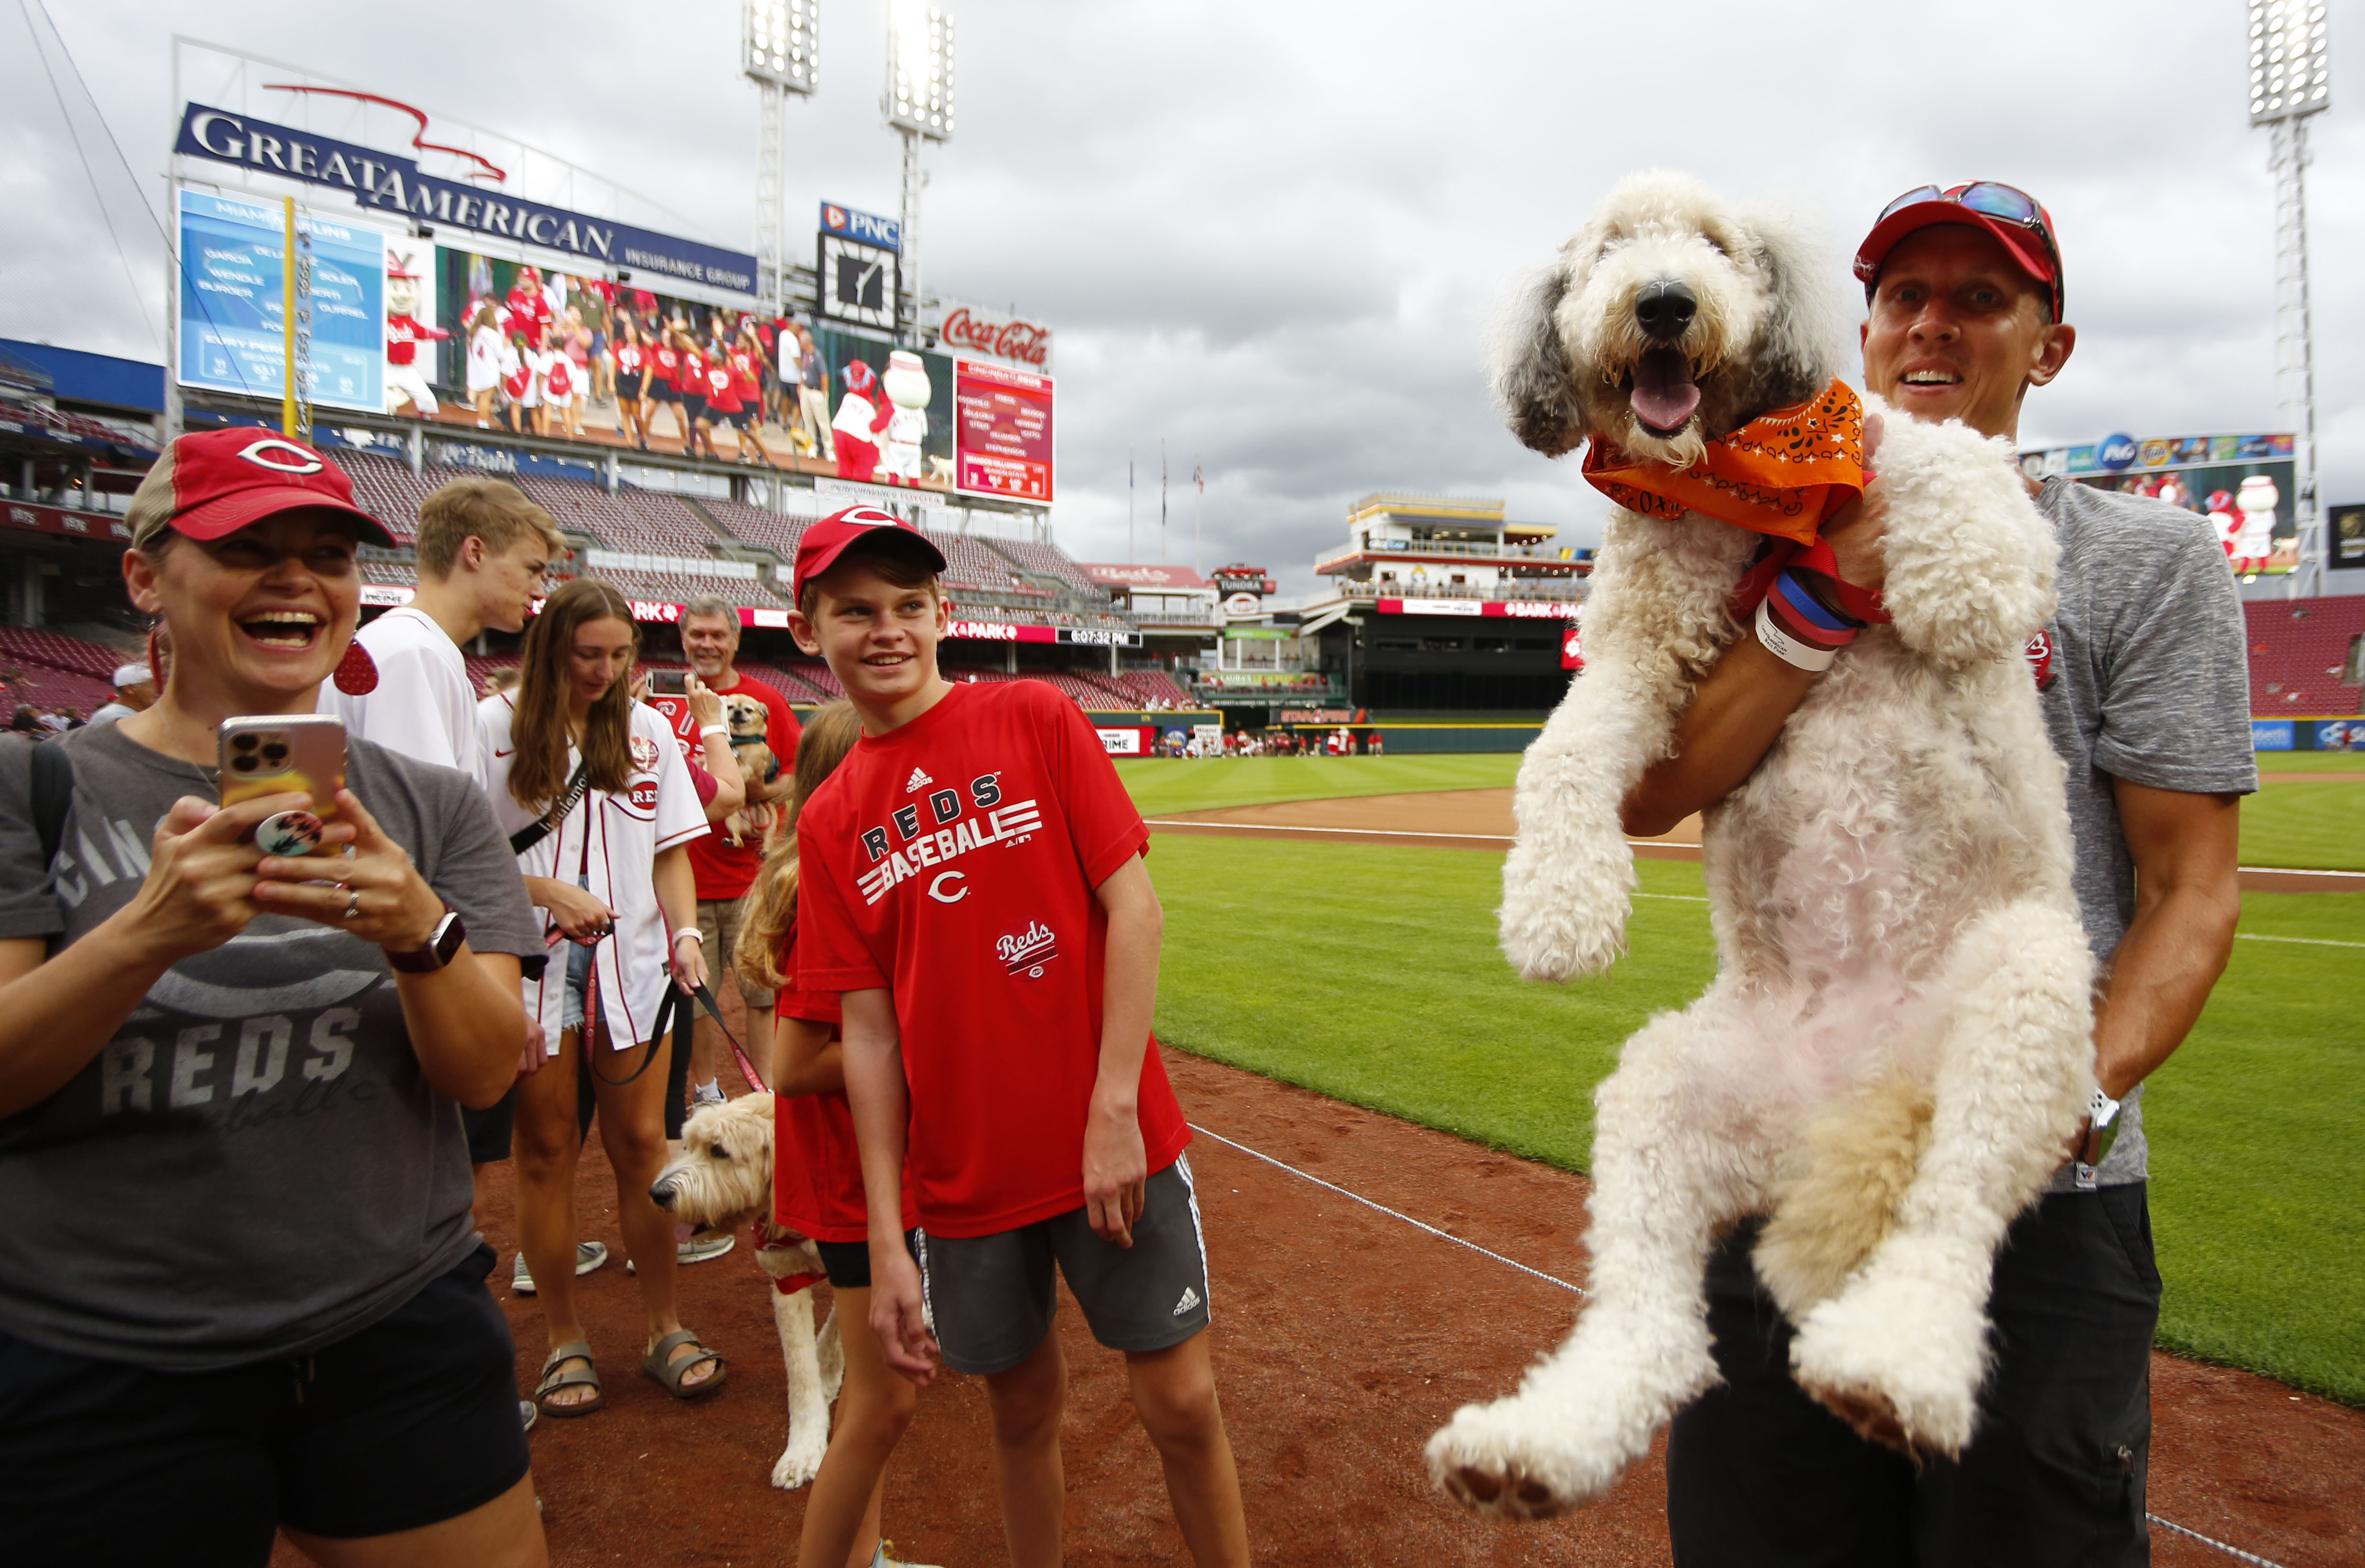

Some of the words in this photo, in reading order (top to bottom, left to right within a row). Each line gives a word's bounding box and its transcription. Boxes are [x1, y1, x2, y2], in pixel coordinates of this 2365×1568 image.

[192, 111, 386, 193] GREAT
[371, 169, 615, 257] AMERICAN
[272, 210, 352, 241] MRLINS
[850, 211, 897, 245] PNC
[204, 247, 253, 266] GARCIA
[208, 268, 264, 286] WENDLE
[318, 269, 358, 286] SOLER
[625, 247, 704, 281] INSURANCE
[706, 266, 750, 291] GROUP
[198, 279, 253, 299] BURGER
[317, 301, 368, 320] GURRIEL
[943, 307, 1051, 365] Coca-Cola
[241, 351, 286, 366] SEASO
[968, 363, 1016, 382] CINCINNATI
[990, 430, 1023, 443] WILLIAMSON
[2102, 443, 2136, 462] P&G
[992, 459, 1026, 472] WILLIAMSON
[830, 484, 896, 499] PERFORMANCE
[899, 492, 941, 504] TOYOTA
[1221, 581, 1260, 590] TUNDRA
[1516, 602, 1553, 618] BARK
[968, 622, 1007, 640] PARK
[1071, 629, 1111, 645] 6:07:32
[1112, 632, 1129, 646] PM
[1104, 739, 1128, 750] RIME
[906, 776, 933, 793] adidas
[631, 789, 657, 804] RE
[861, 774, 1001, 862] REDS
[879, 810, 1015, 891] BASEBALL
[928, 870, 968, 903] C
[996, 920, 1056, 962] Reds
[101, 1006, 363, 1117] REDS
[1173, 1295, 1201, 1316] adidas
